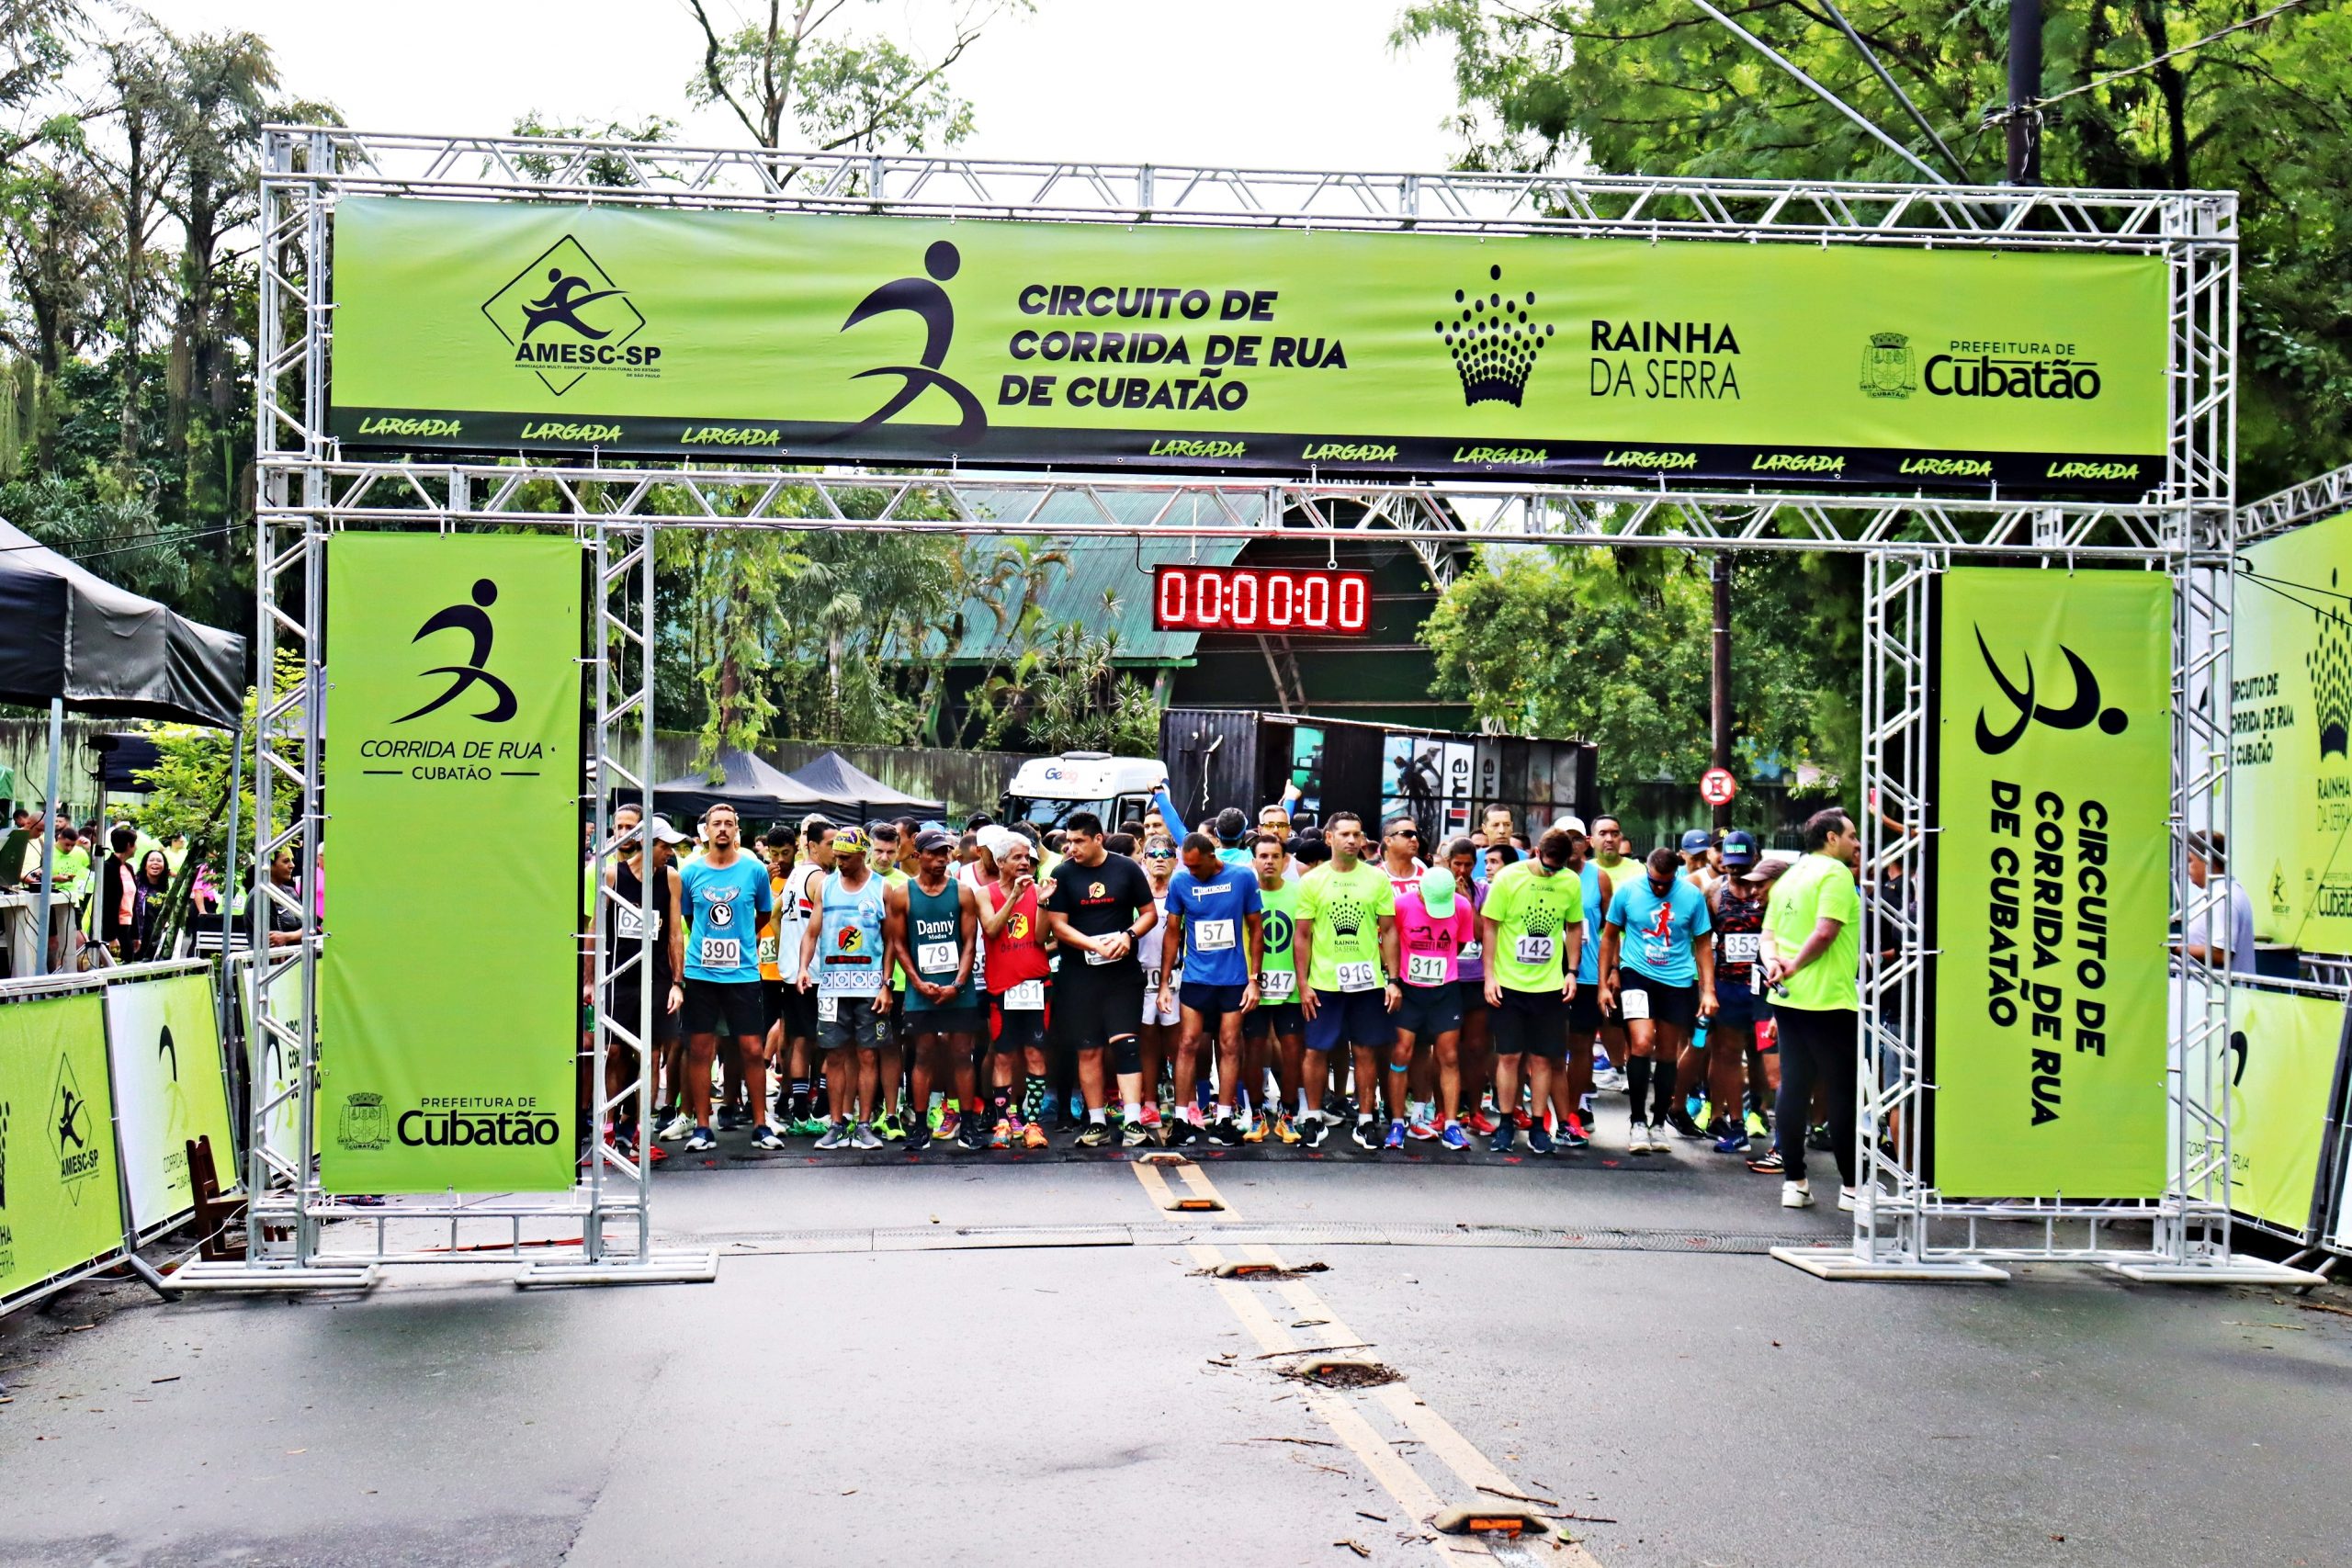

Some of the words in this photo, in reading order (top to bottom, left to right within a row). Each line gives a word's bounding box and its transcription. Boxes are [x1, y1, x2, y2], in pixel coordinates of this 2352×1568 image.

[1018, 284, 1210, 319] CIRCUITO
[1221, 290, 1278, 321] DE
[1590, 321, 1740, 355] RAINHA
[1951, 341, 2051, 355] PREFEITURA
[2055, 344, 2075, 355] DE
[514, 343, 662, 366] AMESC-SP
[1009, 330, 1187, 364] CORRIDA
[1204, 335, 1261, 367] DE
[1270, 337, 1348, 369] RUA
[1590, 358, 1635, 396] DA
[1645, 359, 1740, 400] SERRA
[1924, 355, 2101, 400] Cubatão
[997, 375, 1057, 406] DE
[1066, 367, 1249, 411] CUBATÃO
[358, 416, 461, 439] LARGADA
[521, 422, 622, 444] LARGADA
[681, 426, 782, 447] LARGADA
[1148, 439, 1247, 459] LARGADA
[1301, 443, 1397, 462] LARGADA
[1453, 446, 1548, 467] LARGADA
[1602, 451, 1698, 470] LARGADA
[1751, 454, 1845, 474] LARGADA
[1899, 457, 1993, 478] LARGADA
[2047, 461, 2140, 481] LARGADA
[1161, 572, 1364, 627] 00:00:00
[2231, 676, 2265, 703] IRCUITO
[2267, 672, 2279, 696] DE
[2231, 710, 2260, 734] ORRIDA
[2263, 707, 2275, 730] DE
[2277, 705, 2294, 728] RUA
[360, 739, 456, 759] CORRIDA
[463, 742, 492, 759] DE
[498, 742, 543, 760] RUA
[2236, 733, 2273, 765] CUBATÃO
[412, 764, 492, 781] CUBATÃO
[2318, 777, 2351, 799] RAINHA
[1990, 781, 2020, 838] DE
[2032, 791, 2064, 970] CORRIDA
[2076, 799, 2108, 989] CIRCUITO
[916, 919, 955, 936] Danny
[1204, 923, 1224, 941] 57
[1989, 847, 2029, 1028] CUBATÃO
[704, 941, 737, 959] 390
[762, 939, 777, 956] 38
[926, 946, 949, 964] 79
[1519, 939, 1551, 956] 142
[1728, 936, 1758, 953] 353
[1340, 964, 1373, 983] 916
[1411, 957, 1442, 976] 311
[1260, 973, 1293, 989] 847
[2031, 978, 2062, 1038] DE
[2075, 997, 2105, 1057] DE
[2030, 1049, 2061, 1127] RUA
[421, 1097, 514, 1108] PREFEITURA
[518, 1097, 537, 1107] DE
[397, 1110, 560, 1146] Cubatão
[61, 1149, 98, 1178] AMESC-SP
